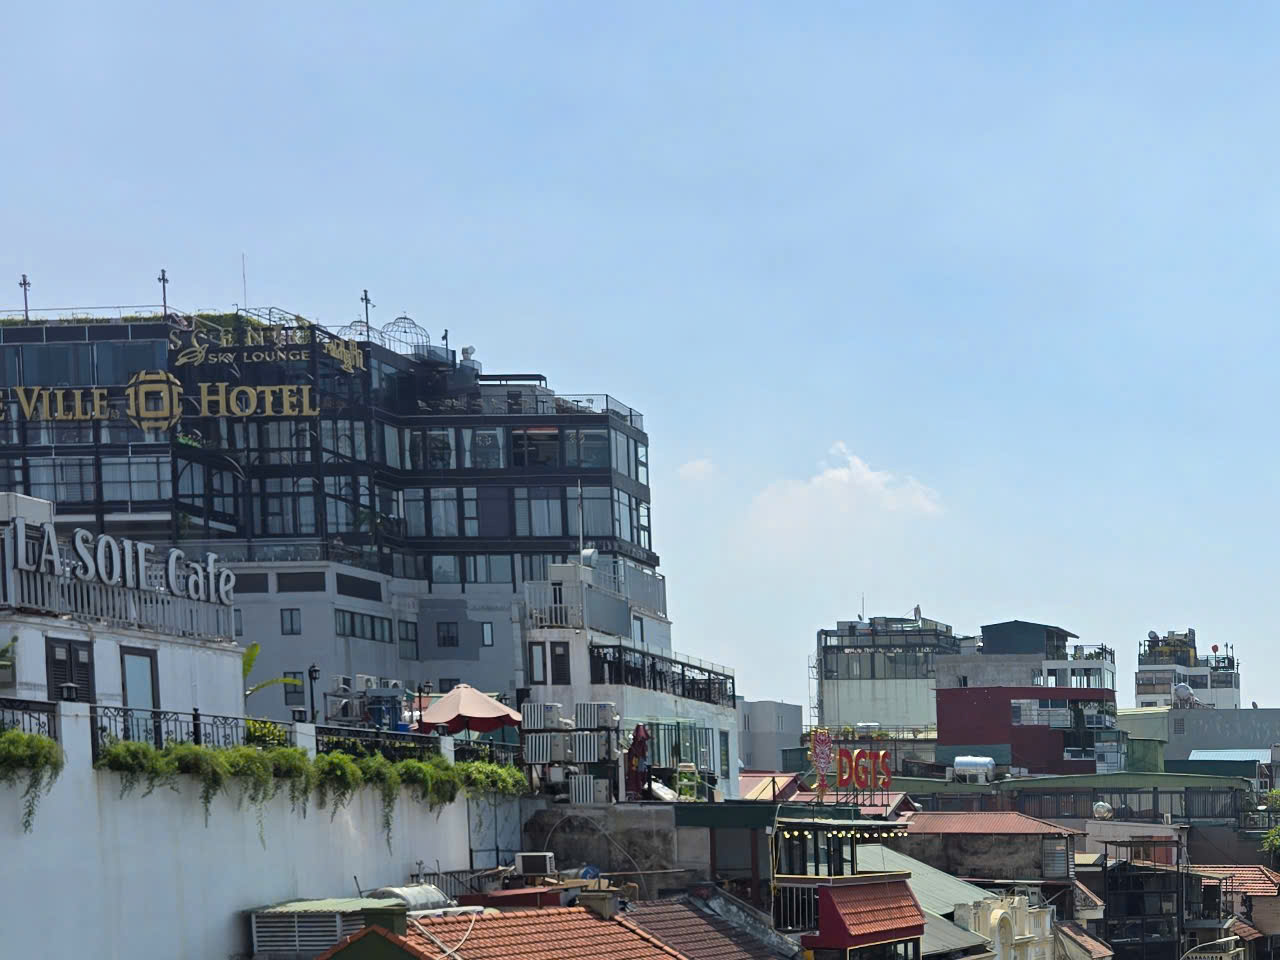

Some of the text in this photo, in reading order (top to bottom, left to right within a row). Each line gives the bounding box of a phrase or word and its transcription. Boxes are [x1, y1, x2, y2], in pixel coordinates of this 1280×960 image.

[208, 349, 311, 364] SKY LOUNGE
[15, 385, 112, 421] VILLE
[198, 382, 320, 417] HOTEL
[14, 516, 236, 607] LA SOIE Cafe
[837, 748, 892, 789] DGTS
